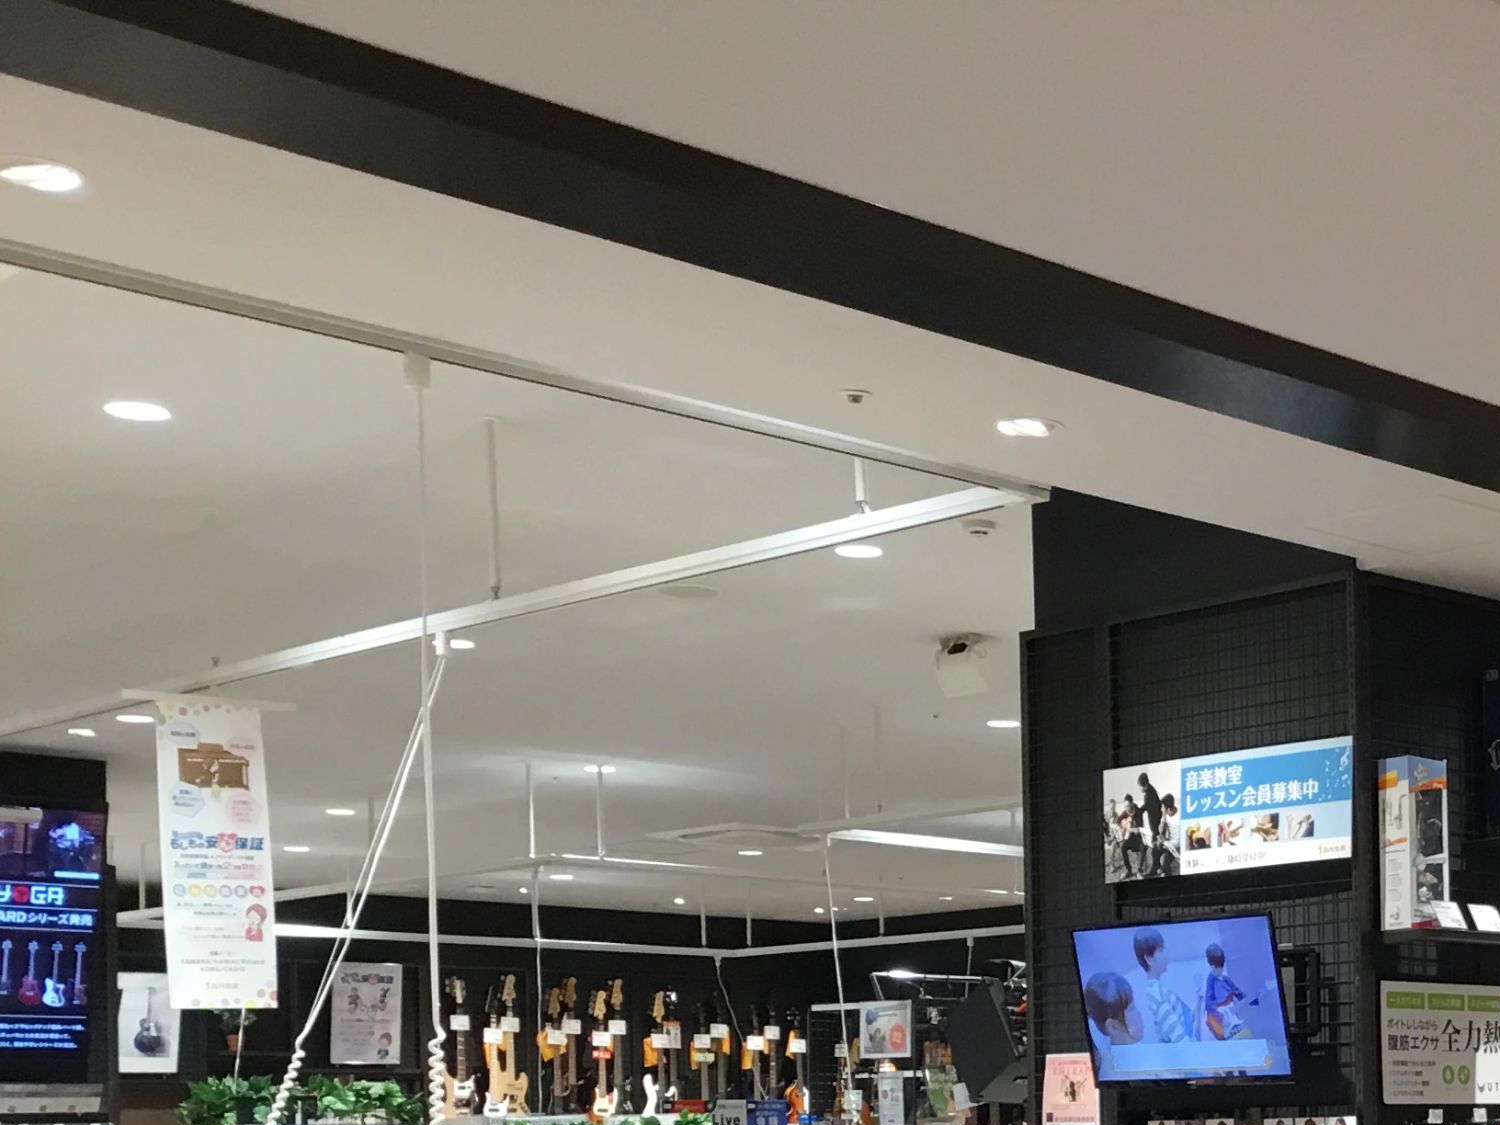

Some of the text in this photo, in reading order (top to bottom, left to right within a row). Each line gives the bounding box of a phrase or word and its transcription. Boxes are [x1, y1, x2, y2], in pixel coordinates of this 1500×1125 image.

[1184, 764, 1243, 792] 音楽教室
[1186, 778, 1319, 814] レッスン会員募集中
[1387, 1034, 1440, 1051] 腹筋エクサ
[712, 1114, 741, 1125] Live
